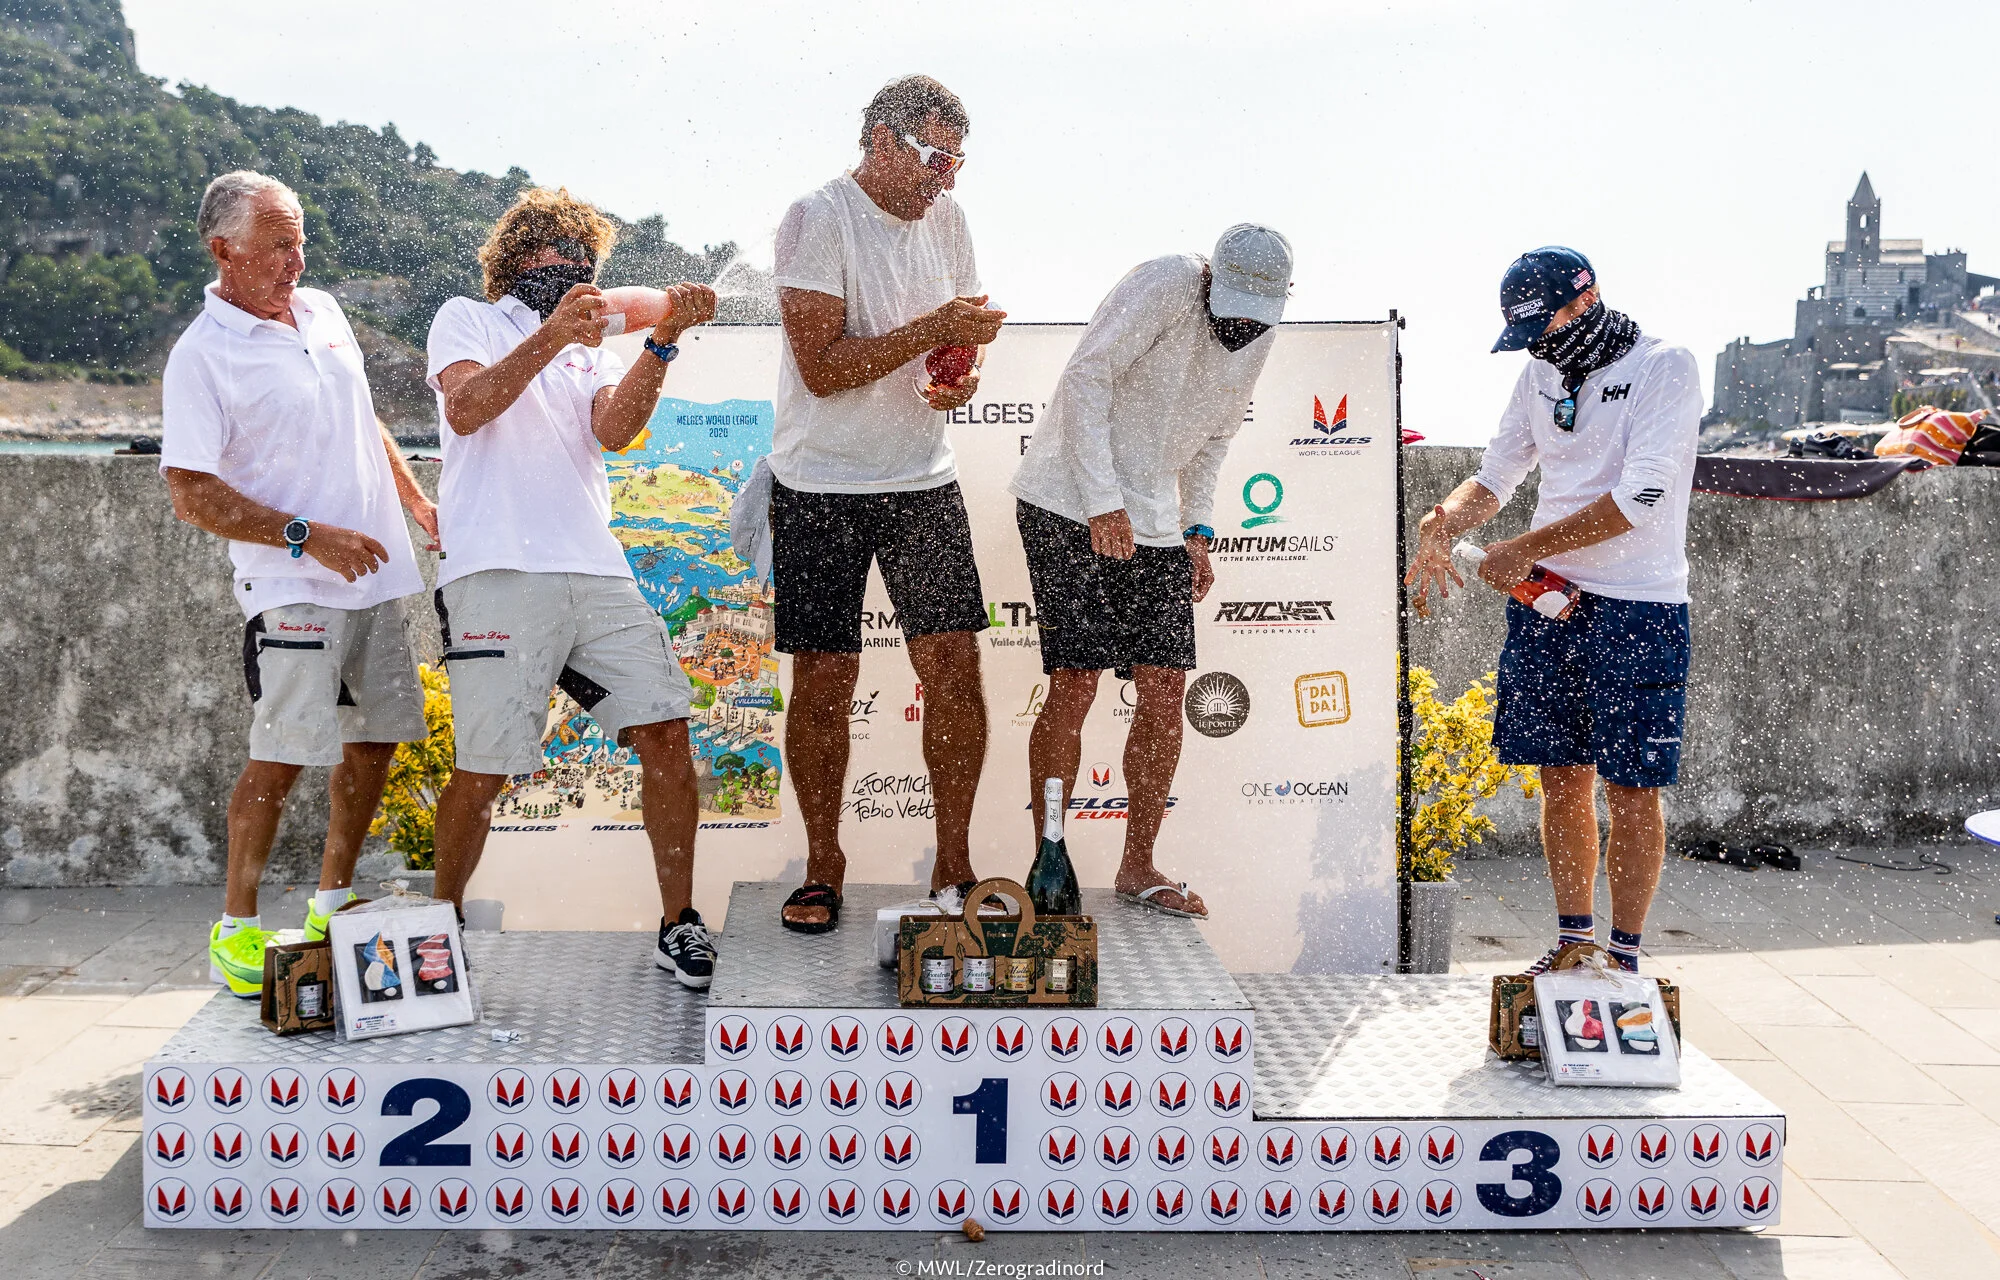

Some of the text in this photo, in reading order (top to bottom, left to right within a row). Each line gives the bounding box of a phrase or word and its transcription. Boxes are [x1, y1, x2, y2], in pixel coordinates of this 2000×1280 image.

[1520, 308, 1541, 318] MAGIC
[706, 415, 731, 425] WORLD
[733, 414, 758, 425] LEAGUE
[709, 428, 728, 437] 2020
[1289, 437, 1372, 445] MELGES
[1214, 601, 1335, 621] ROCKET
[990, 637, 1015, 648] Valle
[1208, 720, 1237, 729] PONTE
[1242, 782, 1348, 796] ONE OCEAN
[852, 798, 893, 822] Fabio
[380, 1078, 472, 1166] 2
[953, 1078, 1008, 1165] 1
[1476, 1130, 1563, 1217] 3
